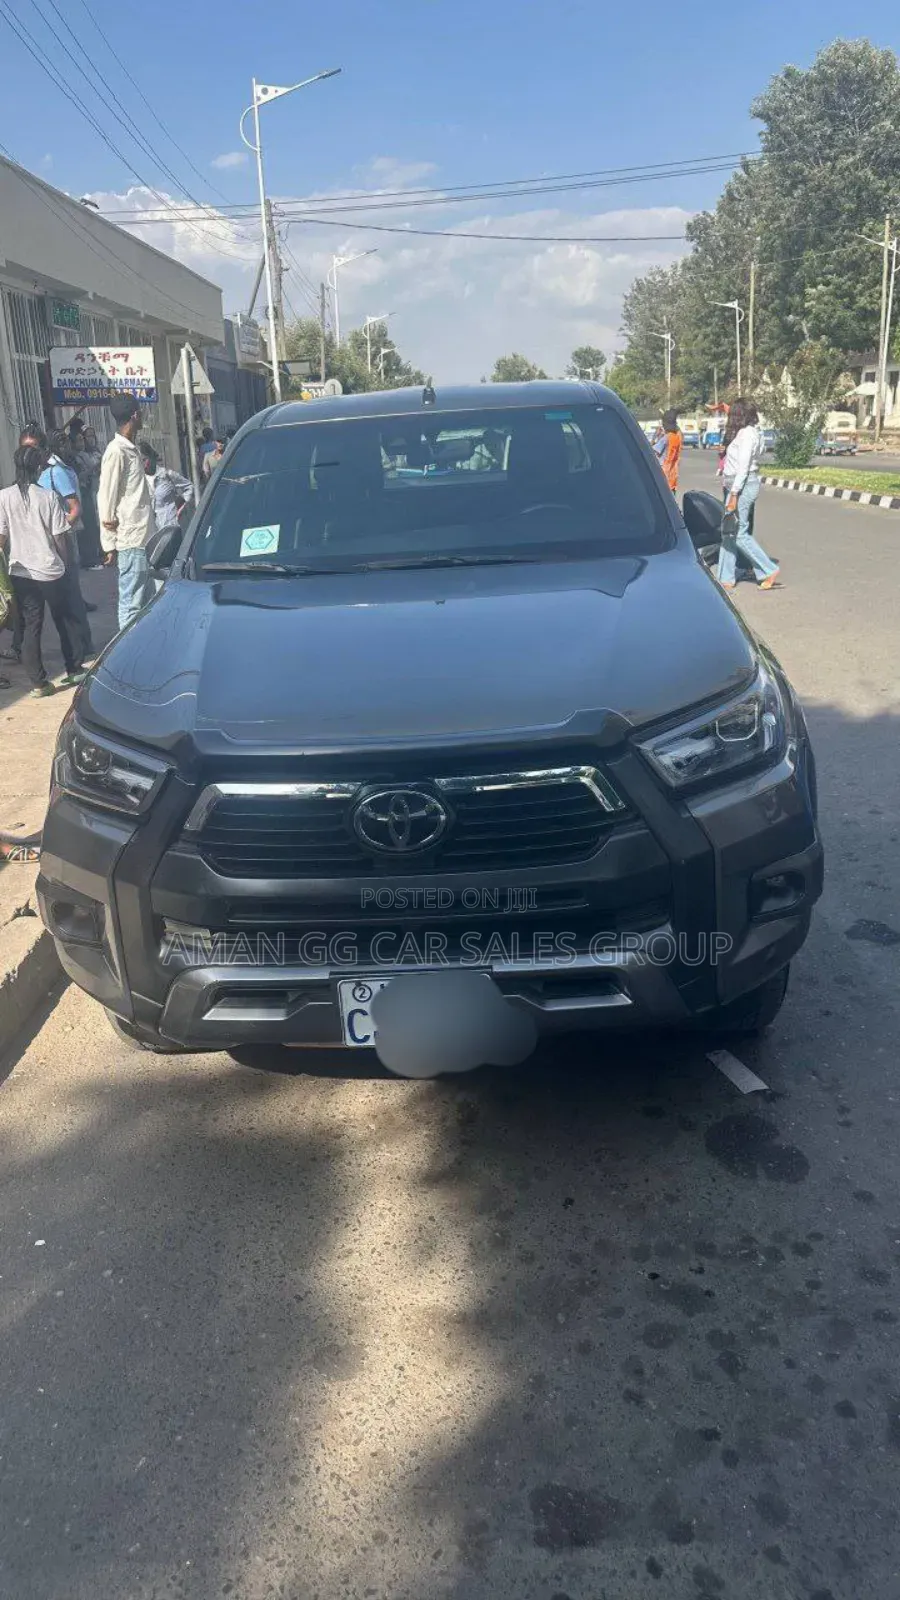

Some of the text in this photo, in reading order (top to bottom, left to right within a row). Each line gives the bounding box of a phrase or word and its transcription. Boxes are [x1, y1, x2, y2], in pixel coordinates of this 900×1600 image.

[125, 366, 147, 376] ቤት
[57, 378, 151, 387] DANCHUMA PHARMACY
[64, 389, 85, 399] Mob.
[135, 388, 147, 399] 74
